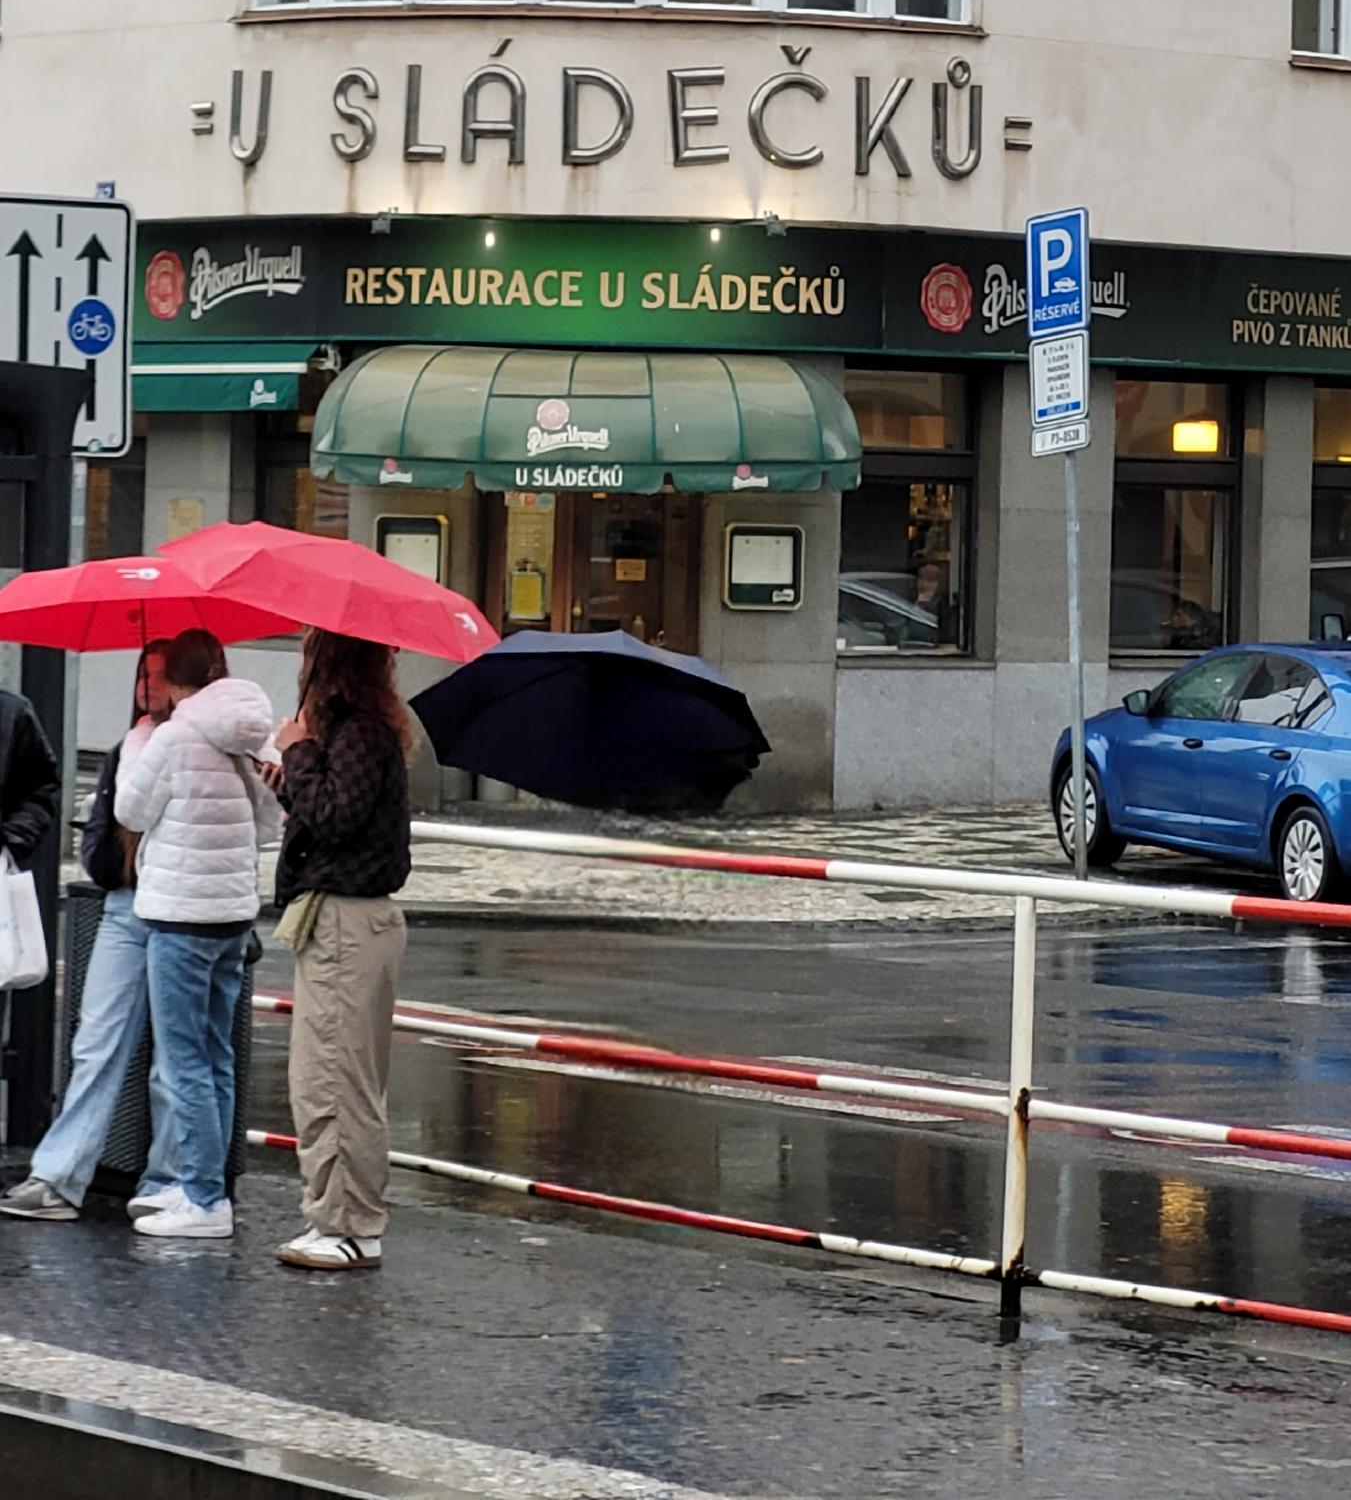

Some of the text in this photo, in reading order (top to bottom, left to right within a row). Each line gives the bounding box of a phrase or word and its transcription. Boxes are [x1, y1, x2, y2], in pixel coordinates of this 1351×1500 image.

[1040, 228, 1073, 298] P
[345, 264, 845, 315] RESTAURACE U SLÁDEČKŮ
[1246, 282, 1342, 318] ČEPOVANÉ
[1232, 319, 1275, 345] PIVO
[1279, 323, 1291, 346] Z
[515, 464, 623, 487] U SLÁDEČKŮ
